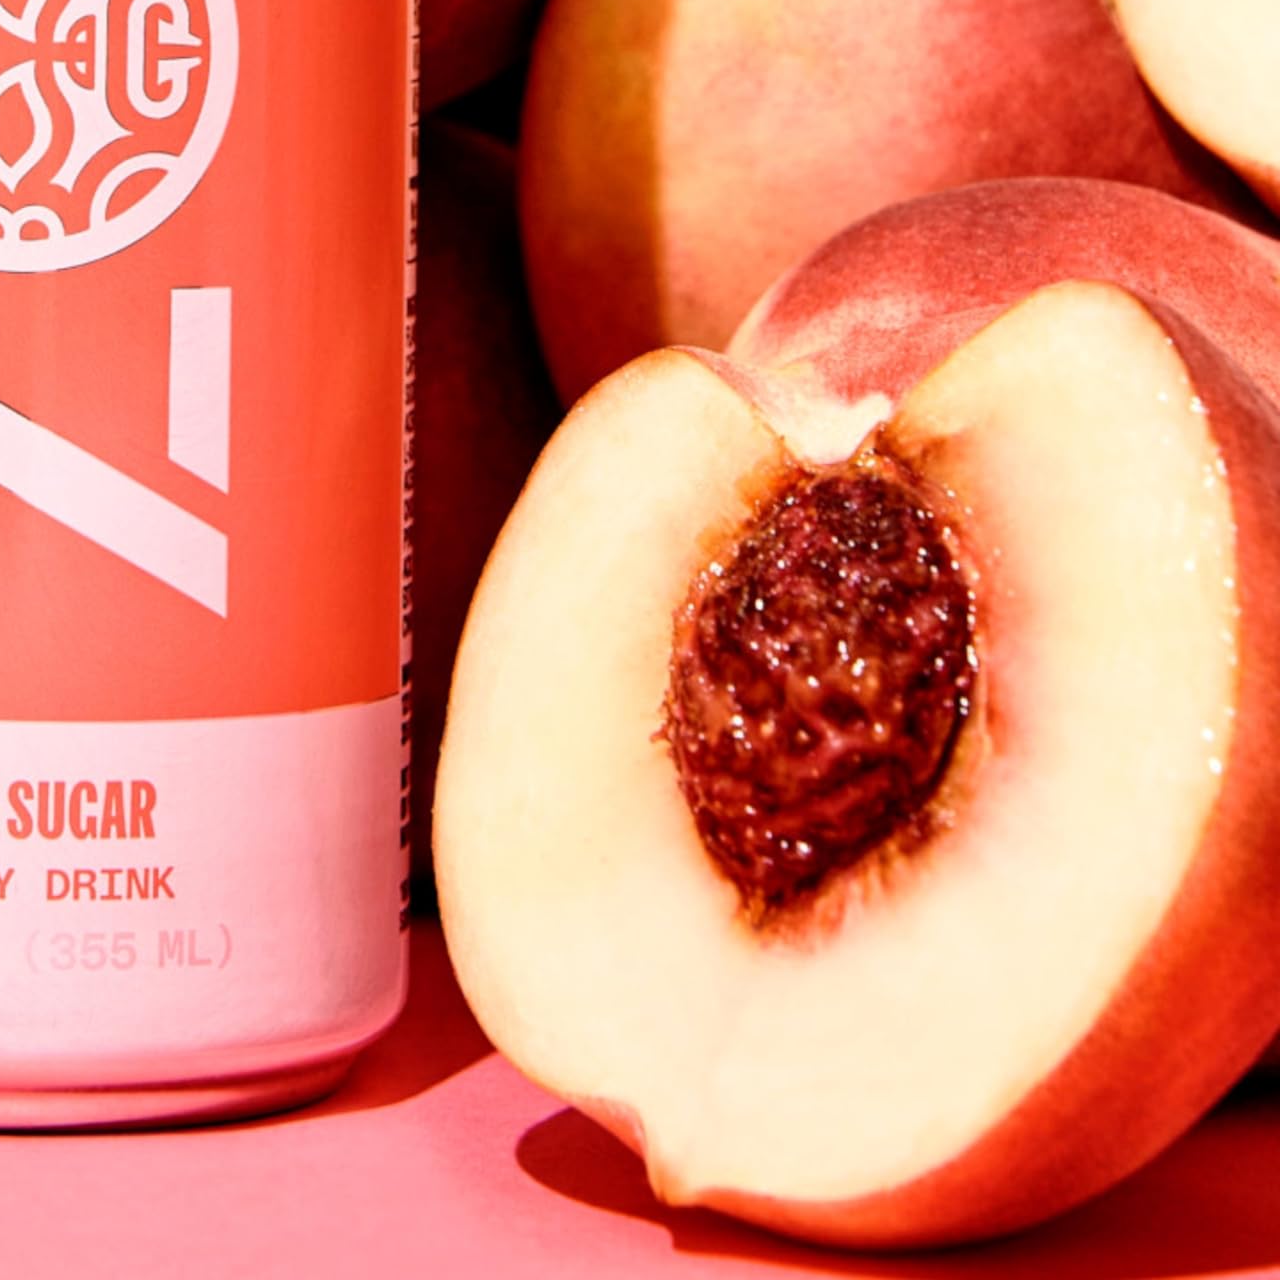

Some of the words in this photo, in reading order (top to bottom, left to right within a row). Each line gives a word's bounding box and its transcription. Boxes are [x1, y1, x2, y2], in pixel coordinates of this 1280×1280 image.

[7, 778, 158, 840] SUGAR
[46, 865, 176, 902] DRINK
[24, 928, 138, 974] (355
[157, 923, 234, 970] ML)
